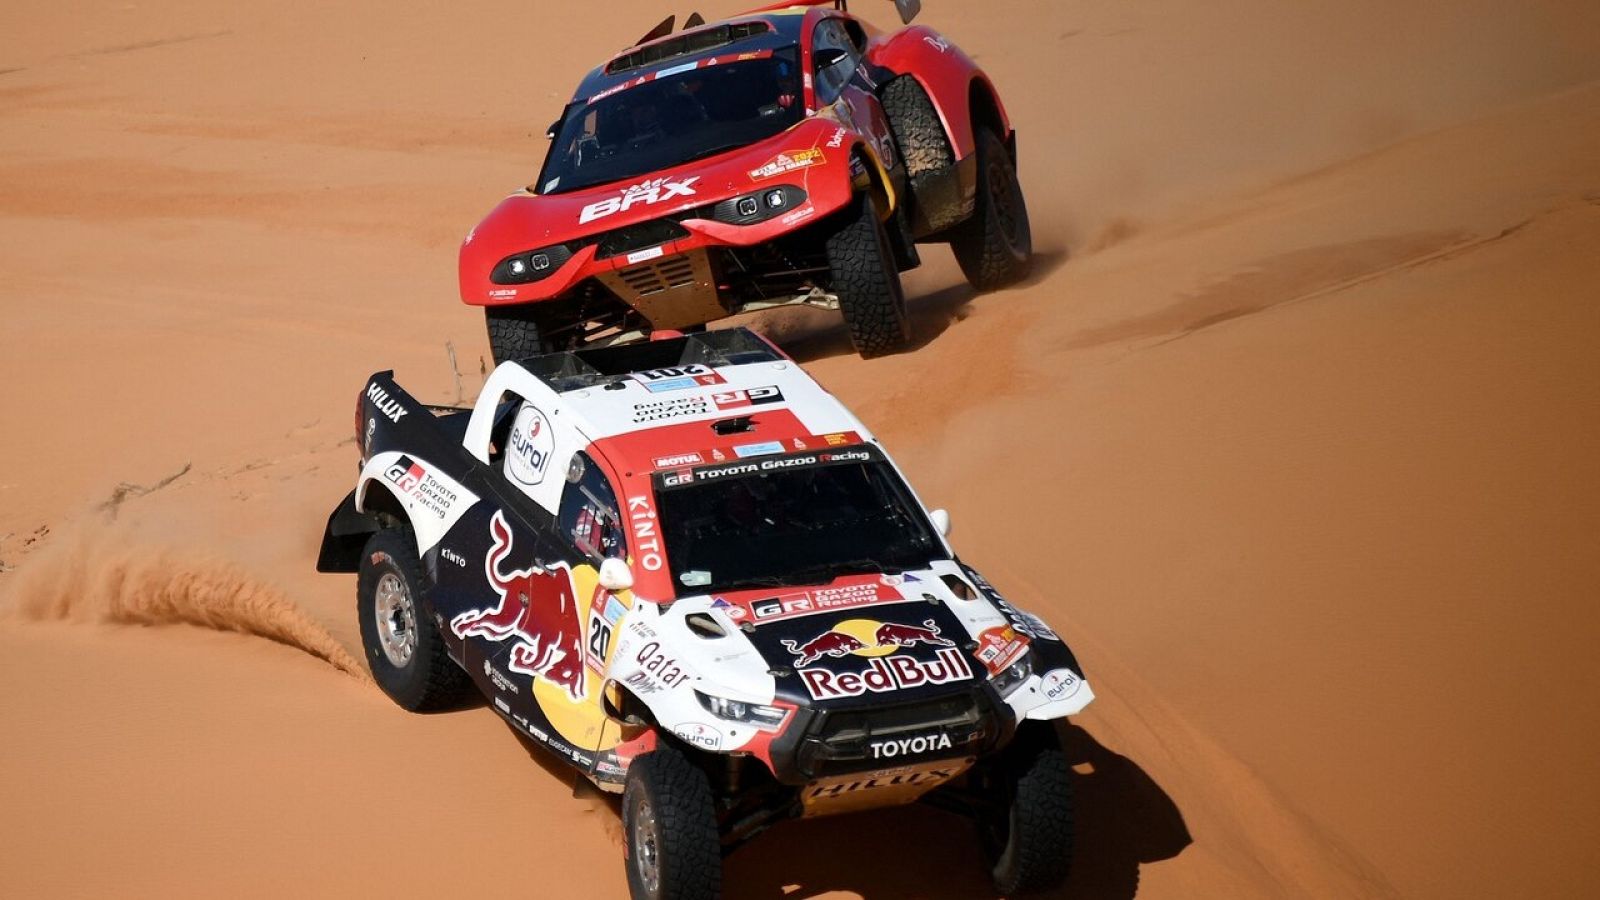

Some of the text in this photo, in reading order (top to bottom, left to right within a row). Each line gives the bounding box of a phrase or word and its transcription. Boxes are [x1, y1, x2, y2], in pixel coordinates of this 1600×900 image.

[579, 176, 700, 224] BRX
[366, 382, 408, 424] HILUX
[712, 385, 781, 405] GR
[512, 428, 548, 473] eurol
[656, 455, 701, 468] MOTUL
[384, 460, 422, 493] GR
[664, 450, 870, 487] GR TOYOTA GAZOO Racing
[418, 483, 451, 510] GAZOO
[425, 473, 457, 503] TOYOTA
[412, 491, 446, 520] Racing
[813, 583, 879, 597] TOYOTA
[816, 589, 877, 602] GAZOO
[817, 595, 878, 609] Racing
[755, 597, 812, 617] GR
[636, 642, 691, 689] Qatar
[802, 658, 895, 698] Red
[890, 648, 971, 687] Bull
[1046, 674, 1076, 699] eurol
[677, 731, 719, 747] eurol
[870, 733, 952, 759] TOYOTA
[810, 768, 951, 798] HILUX
